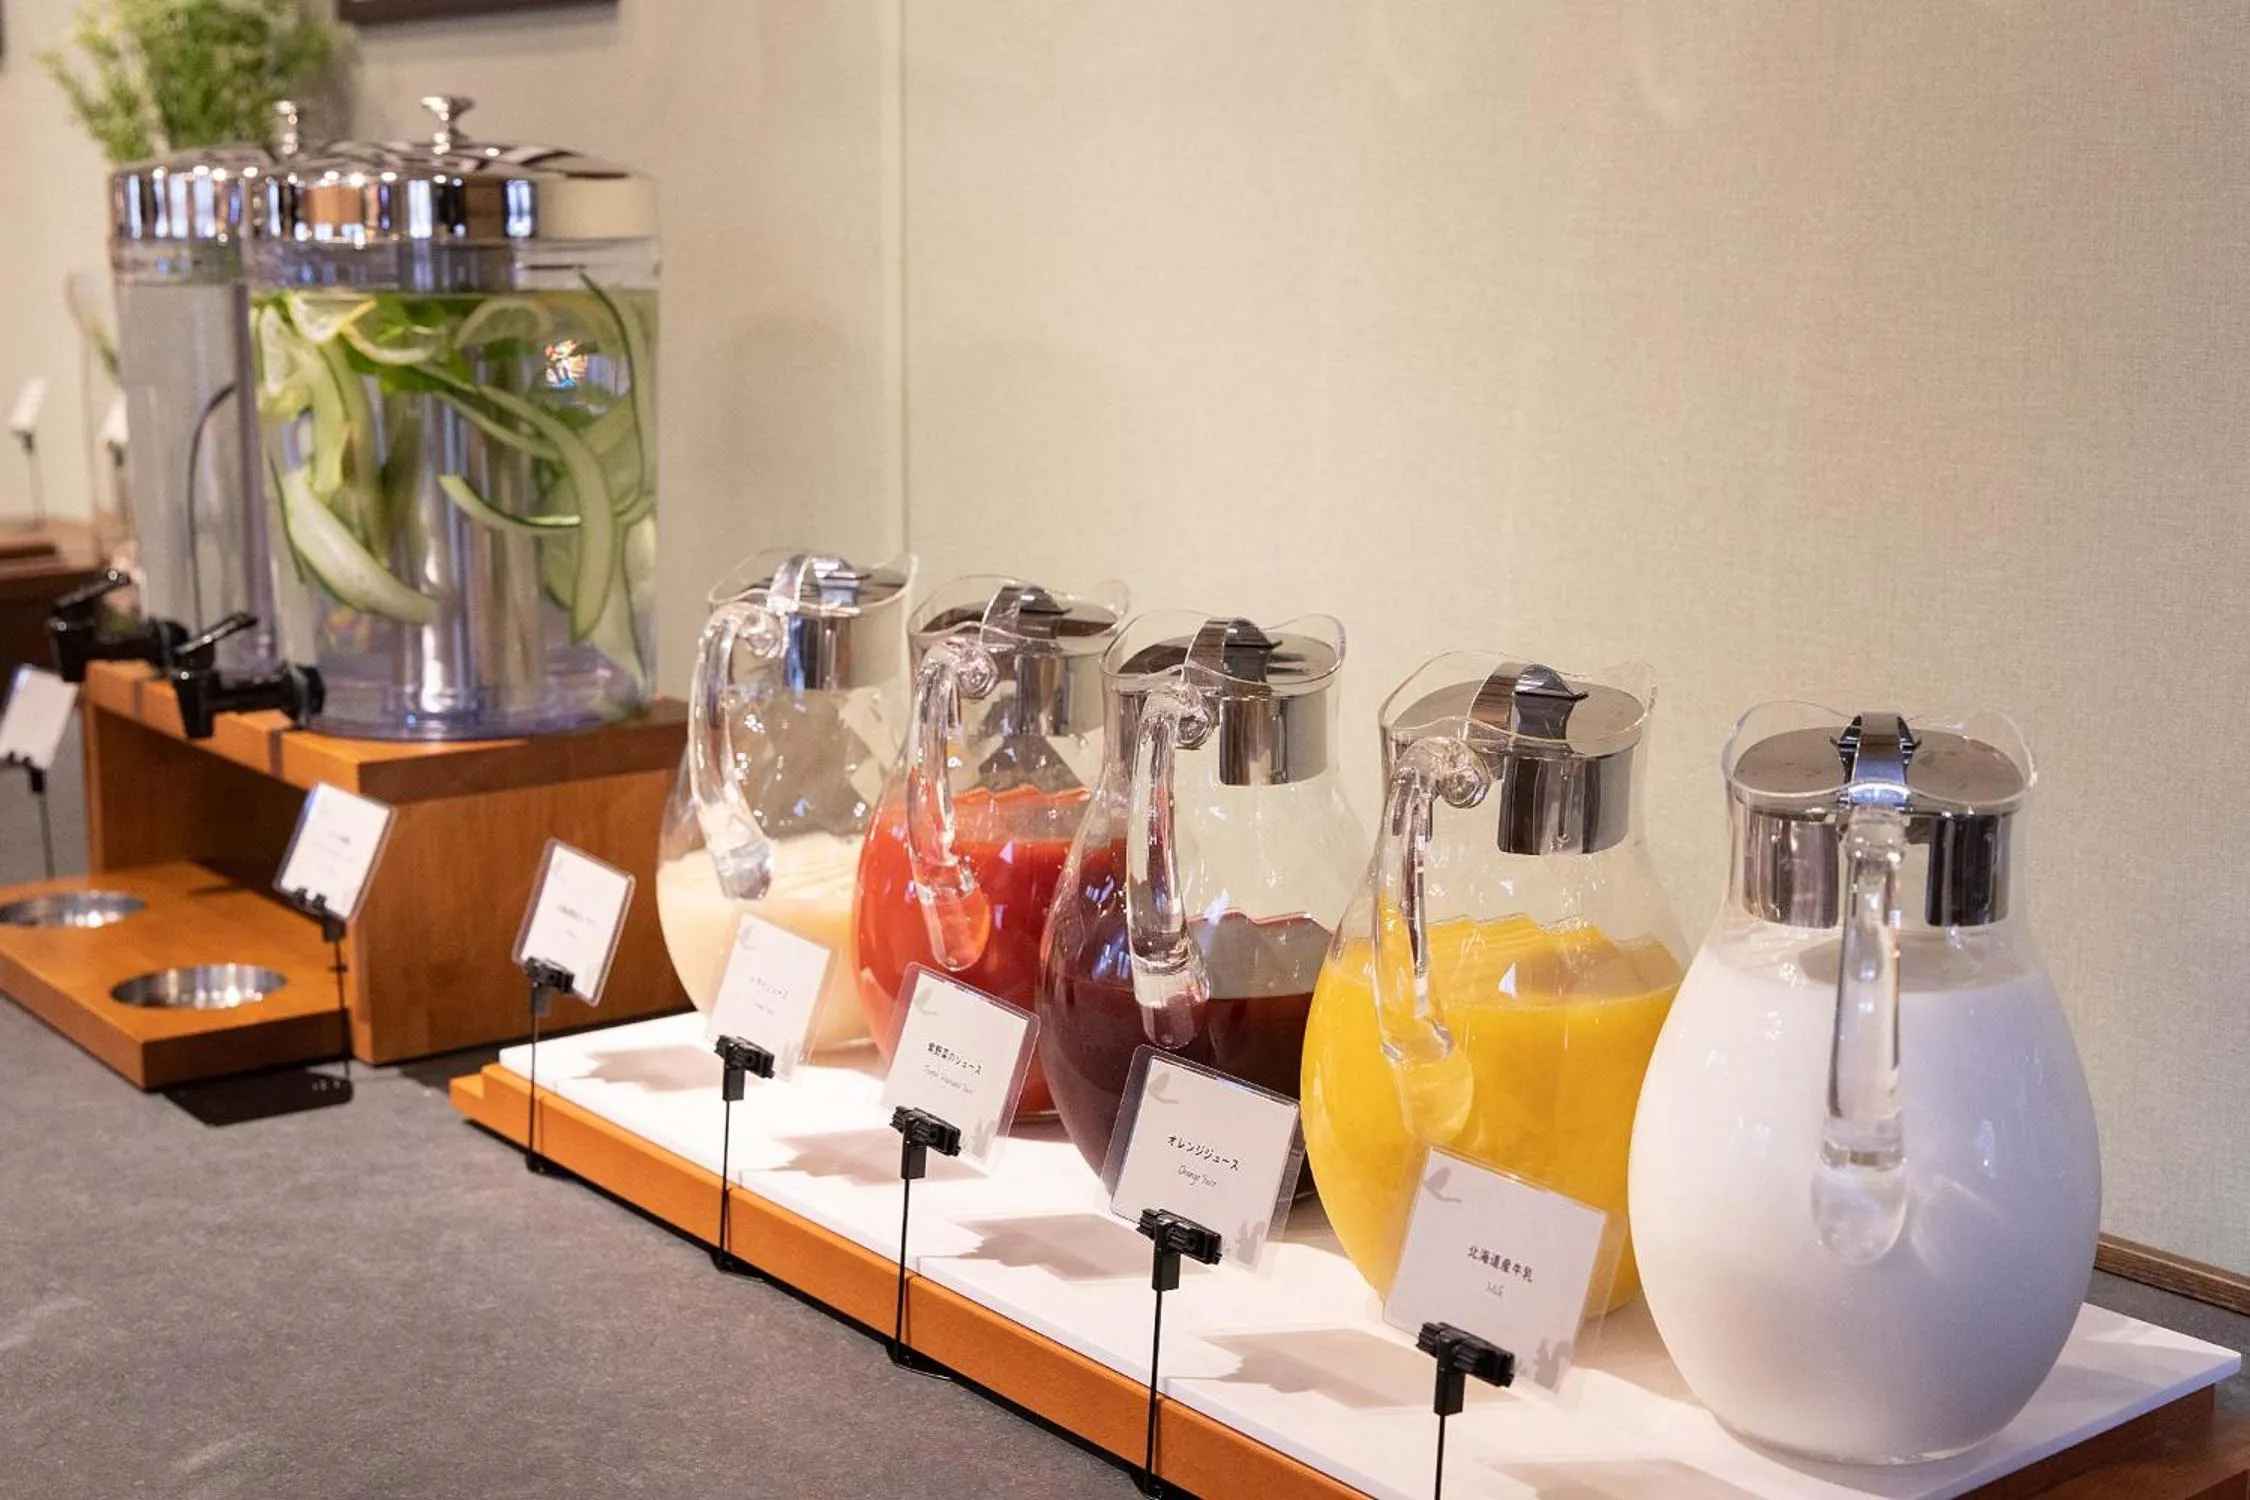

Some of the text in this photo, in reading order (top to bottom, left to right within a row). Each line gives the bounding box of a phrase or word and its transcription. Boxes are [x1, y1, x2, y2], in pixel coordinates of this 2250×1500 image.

[1168, 1135, 1239, 1171] オレンジジュース
[1467, 1246, 1533, 1283] 北海道産牛乳
